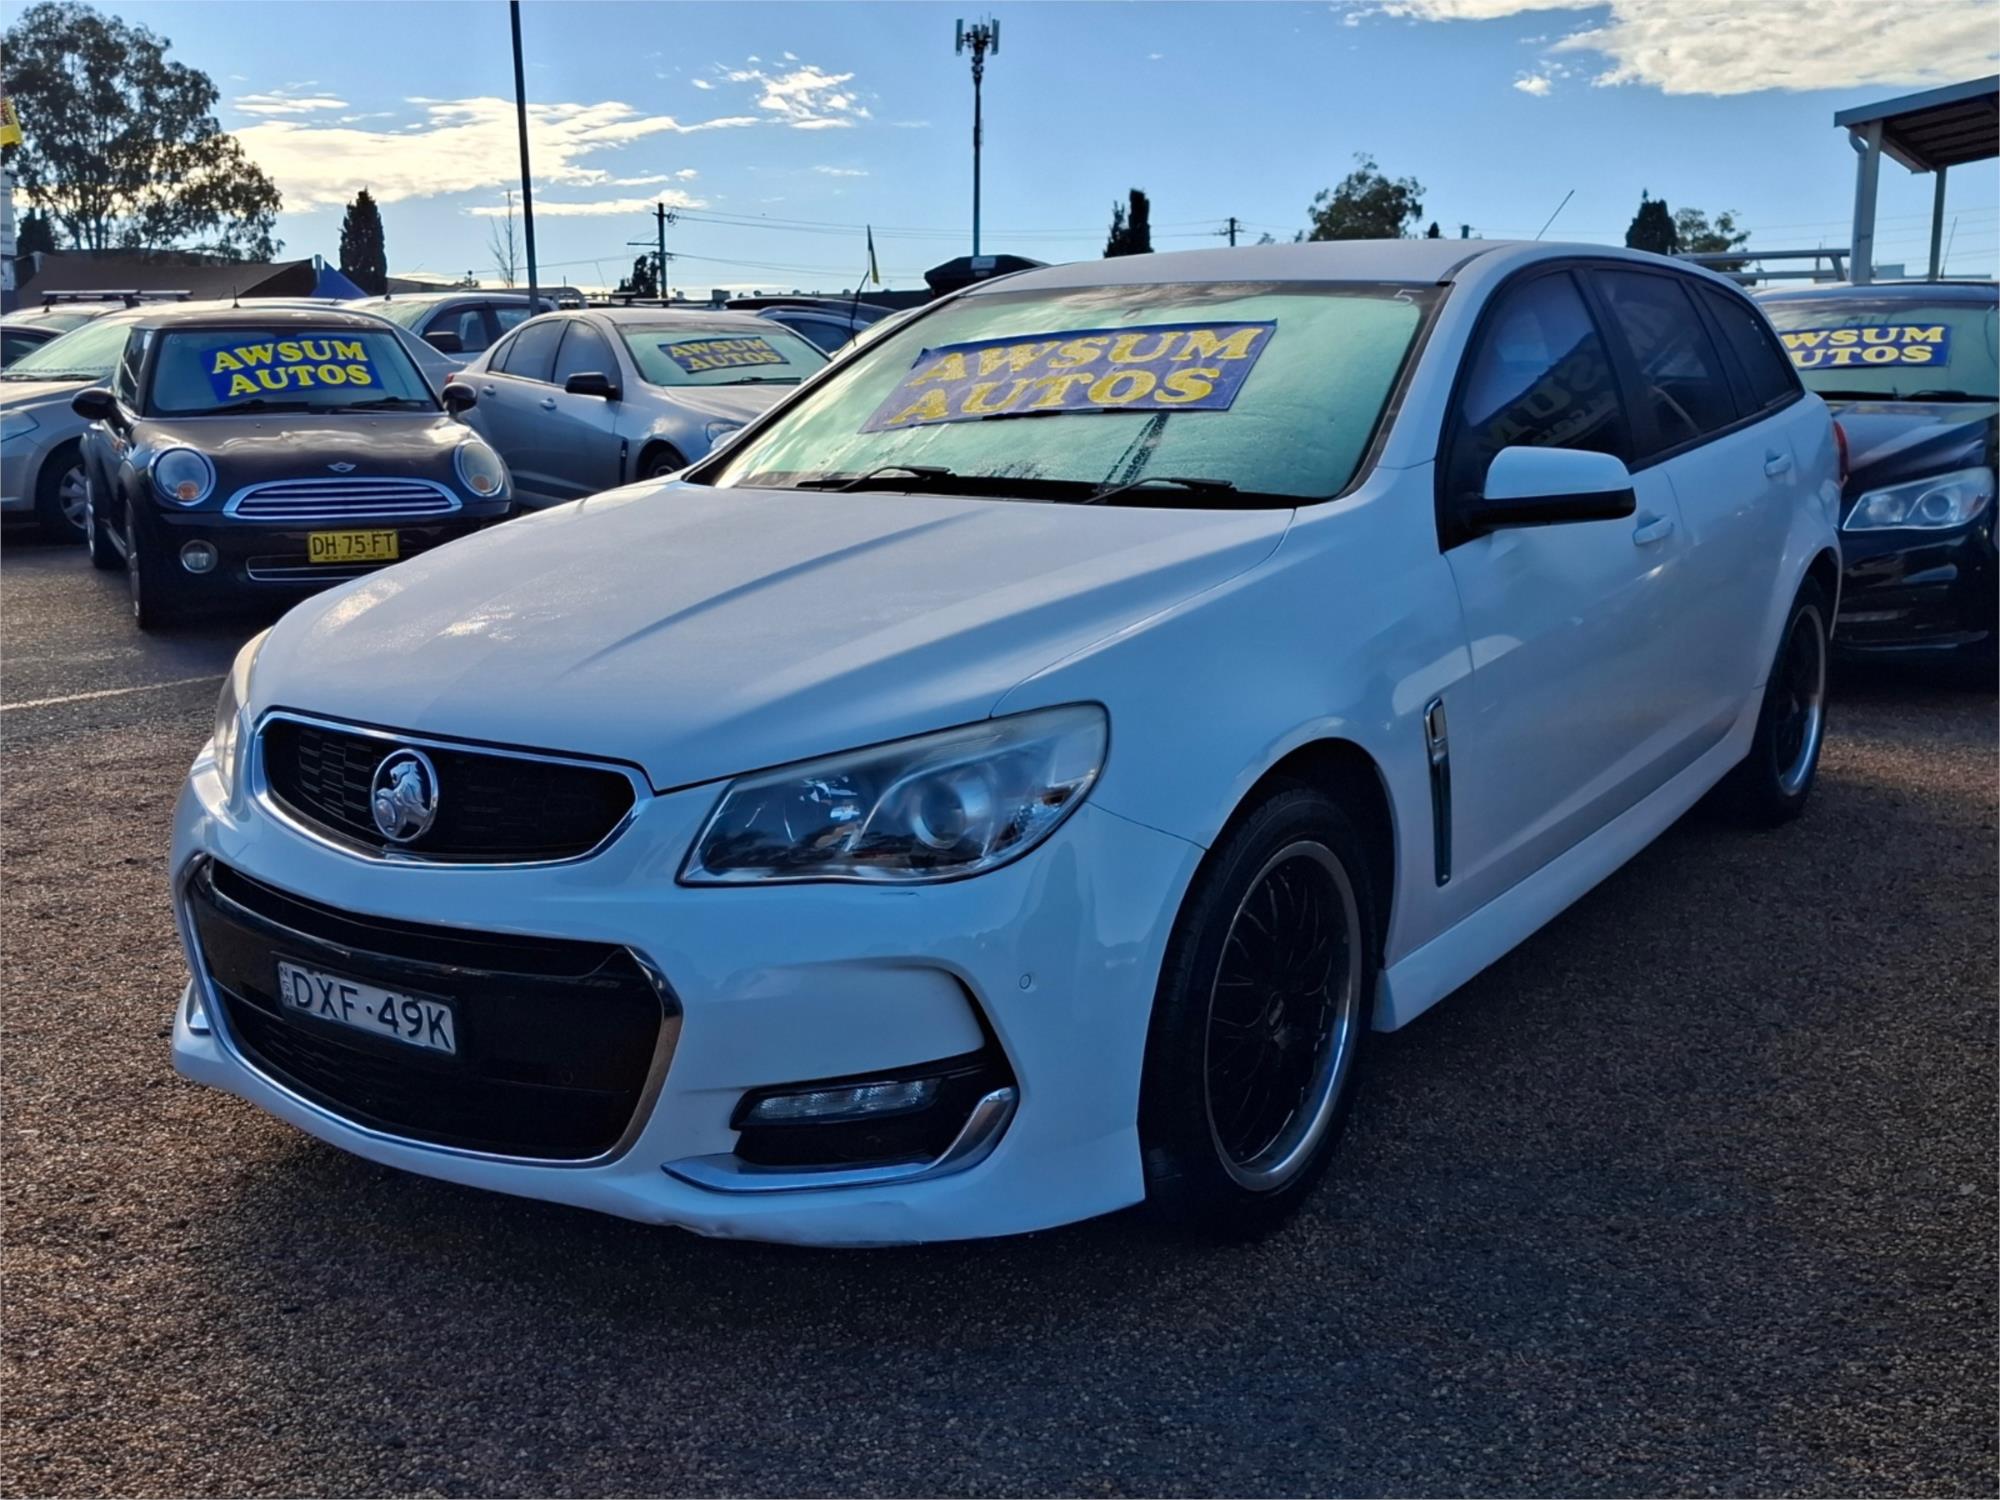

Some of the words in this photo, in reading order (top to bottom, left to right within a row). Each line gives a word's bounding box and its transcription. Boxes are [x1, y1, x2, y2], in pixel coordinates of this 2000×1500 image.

[669, 339, 772, 357] AWSUM
[1779, 326, 1945, 349] WSUM
[212, 340, 368, 374] AWSUM
[689, 351, 782, 371] AUTOS
[905, 328, 1262, 386] AWSUM
[1789, 345, 1933, 367] UTOS
[228, 364, 372, 396] AUTOS
[888, 368, 1221, 425] AUTOS
